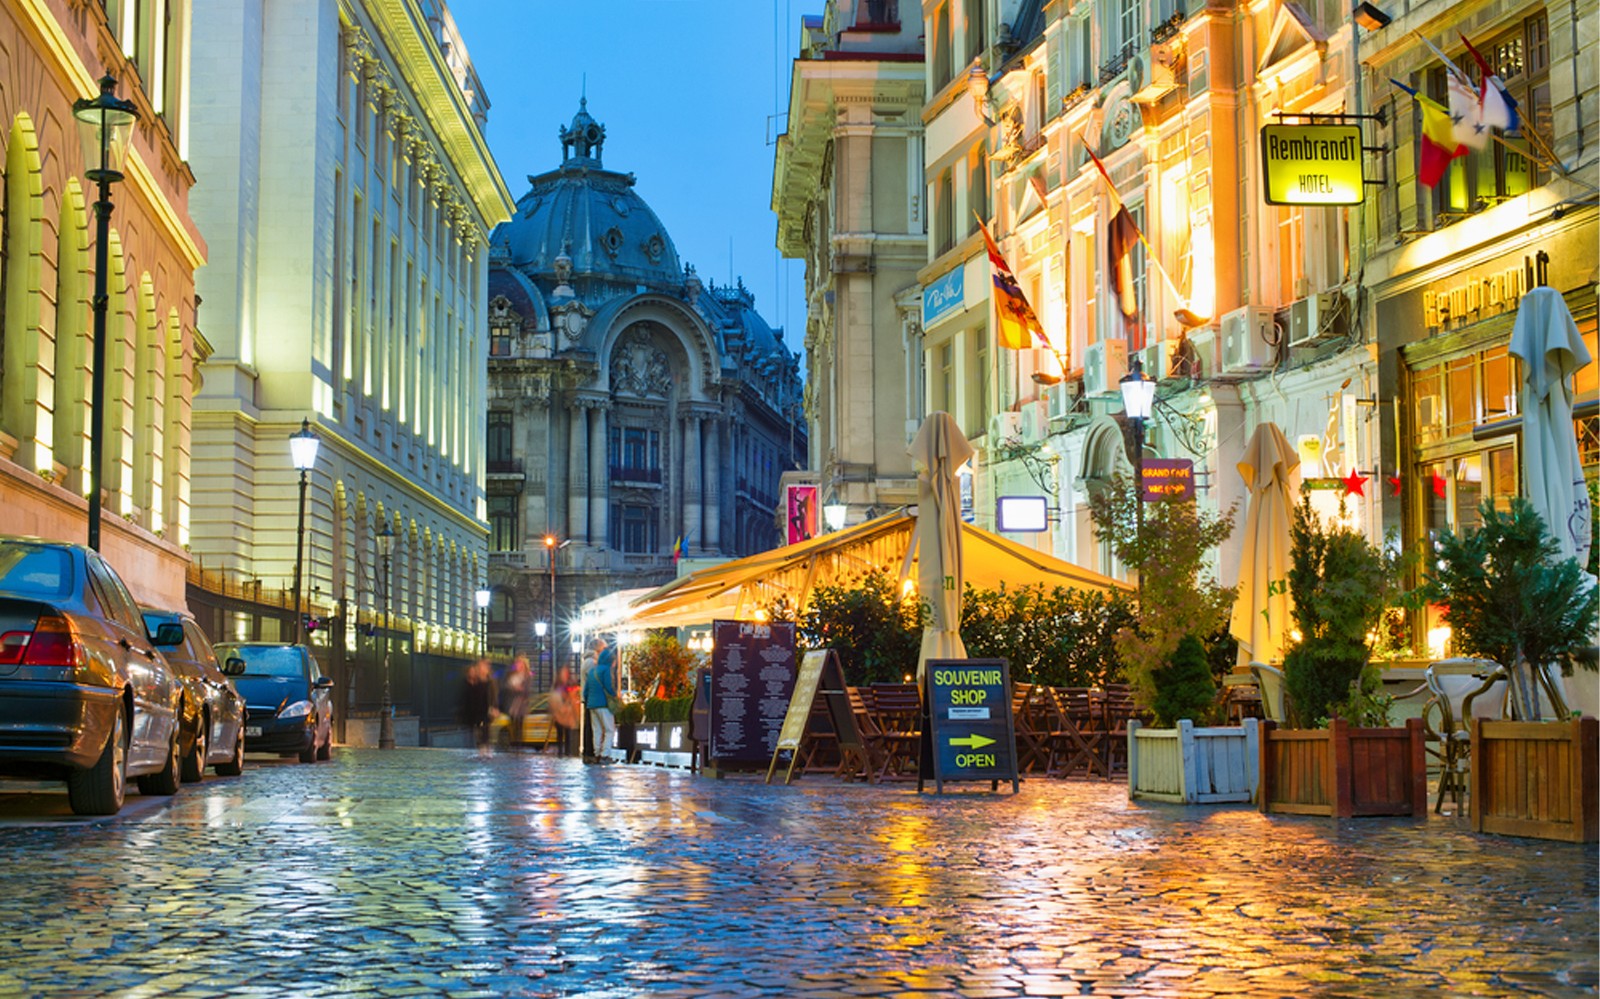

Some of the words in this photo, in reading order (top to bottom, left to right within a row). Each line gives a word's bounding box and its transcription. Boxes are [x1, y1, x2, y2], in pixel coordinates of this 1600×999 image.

[1298, 174, 1333, 193] HOTEL
[1142, 467, 1170, 478] GRAND
[934, 670, 1002, 686] SOUVENIR
[950, 689, 987, 705] SHOP
[955, 753, 996, 768] OPEN
